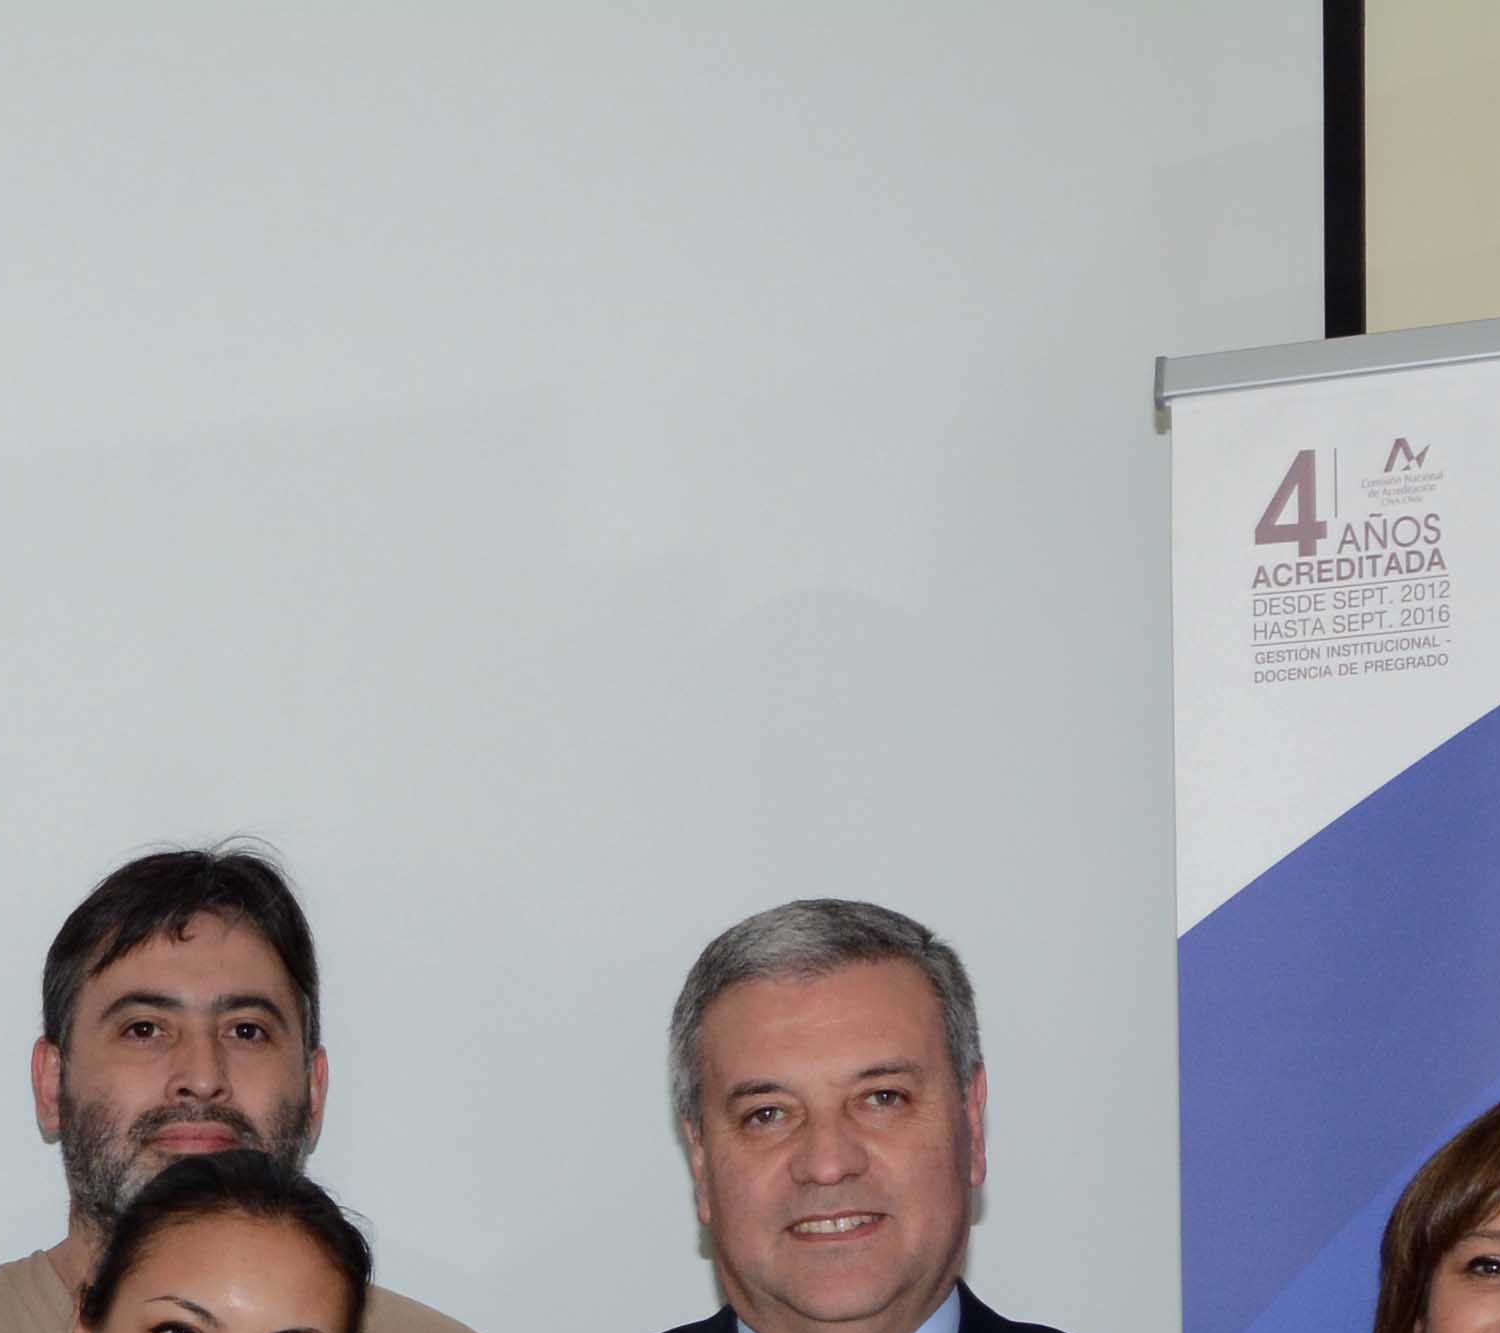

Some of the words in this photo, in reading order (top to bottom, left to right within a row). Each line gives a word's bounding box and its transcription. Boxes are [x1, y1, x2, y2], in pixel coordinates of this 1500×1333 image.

[1254, 448, 1328, 558] 4
[1336, 513, 1443, 555] AÑOS
[1251, 547, 1447, 590] ACREDITADA
[1252, 593, 1325, 617] DESDE
[1333, 586, 1394, 611] SEPT.
[1400, 580, 1451, 603] 2012
[1252, 617, 1326, 641] HASTA
[1332, 610, 1394, 635] SEPT.
[1400, 604, 1451, 628] 2016
[1253, 663, 1333, 684] DOCENCIA
[1338, 661, 1359, 676] DE
[1363, 652, 1449, 673] PREGRADO
[1254, 643, 1321, 666] GESTIÓN
[1326, 635, 1441, 659] INSTITUCIONAL
